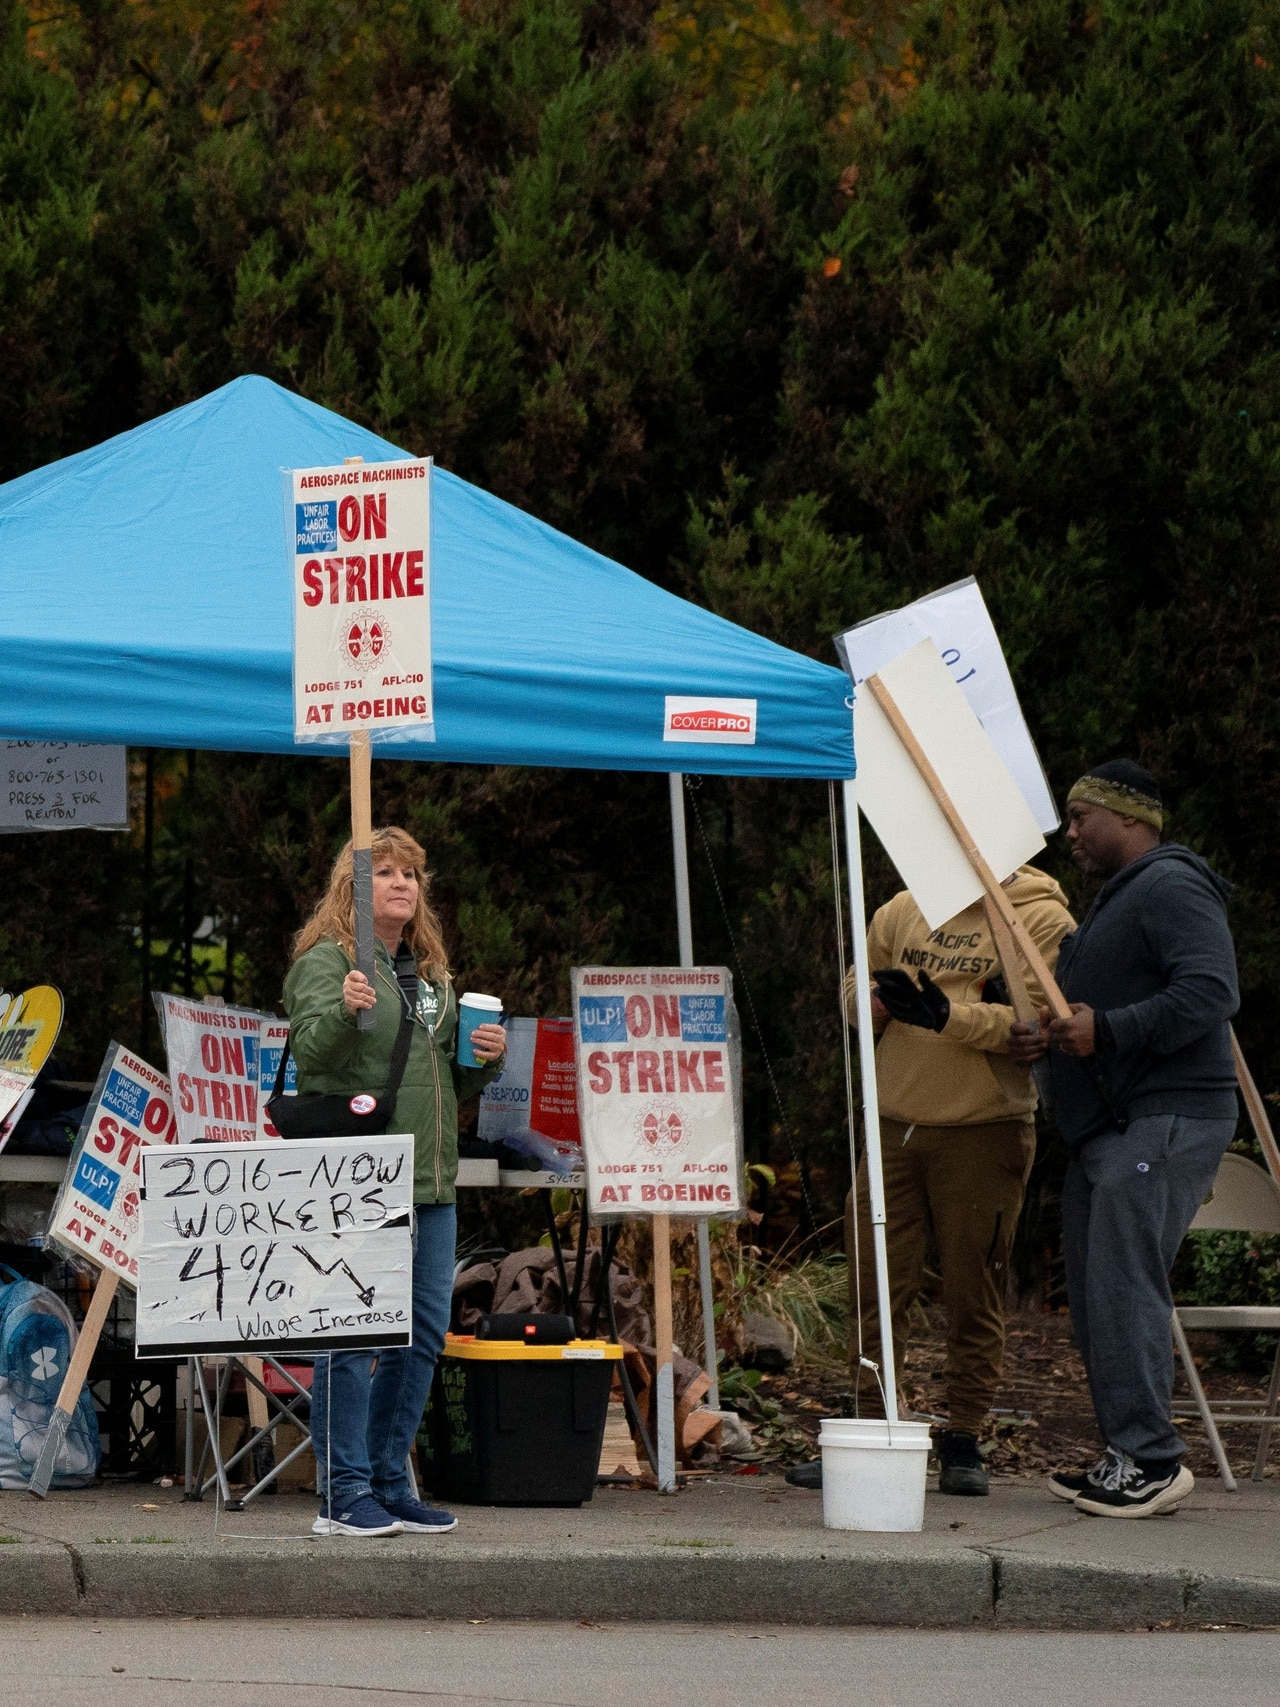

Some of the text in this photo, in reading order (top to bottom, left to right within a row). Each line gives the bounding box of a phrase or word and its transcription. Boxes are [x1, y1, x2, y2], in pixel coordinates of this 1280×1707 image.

[300, 466, 425, 489] AEROSPACE MACHINISTS
[304, 503, 329, 517] UNFAIR
[338, 492, 387, 543] ON
[305, 518, 328, 531] LABOR
[297, 530, 337, 545] PRACTICES!
[303, 550, 424, 607] STRIKE
[305, 673, 424, 693] LODGE 751 AFL-CIO
[305, 695, 426, 725] AT BOEING
[672, 716, 748, 730] COVERPRO
[9, 791, 46, 806] PRESS
[72, 791, 101, 805] FOR
[25, 808, 76, 821] RENTON
[925, 929, 982, 950] PACIFIC
[900, 947, 996, 974] NORTHWEST
[583, 973, 720, 986] AEROSPACE MACHINISTS
[168, 1002, 237, 1029] MACHINISTS
[688, 998, 716, 1010] UNFAIR
[584, 994, 681, 1038] ULP! ON
[691, 1010, 715, 1022] LABOR
[682, 1022, 725, 1034] PRACTICES!
[201, 1033, 245, 1077] ON
[548, 1060, 577, 1069] Locatio
[121, 1054, 172, 1096] AEROSPAC
[587, 1050, 725, 1095] STRIKE
[115, 1086, 138, 1107] LABOR
[117, 1075, 142, 1098] UNFAIR
[178, 1072, 258, 1124] STRI
[491, 1087, 529, 1103] SEAFOOD
[104, 1090, 142, 1121] PRACTICES!
[81, 1163, 115, 1195] ULP!
[598, 1163, 728, 1174] LODGE 751 AFL-CIO
[600, 1183, 732, 1203] AT BOEING
[73, 1200, 127, 1242] LODGE 751
[173, 1188, 387, 1239] WORKERS
[66, 1217, 97, 1245] AT
[236, 1307, 408, 1340] Wage Increase
